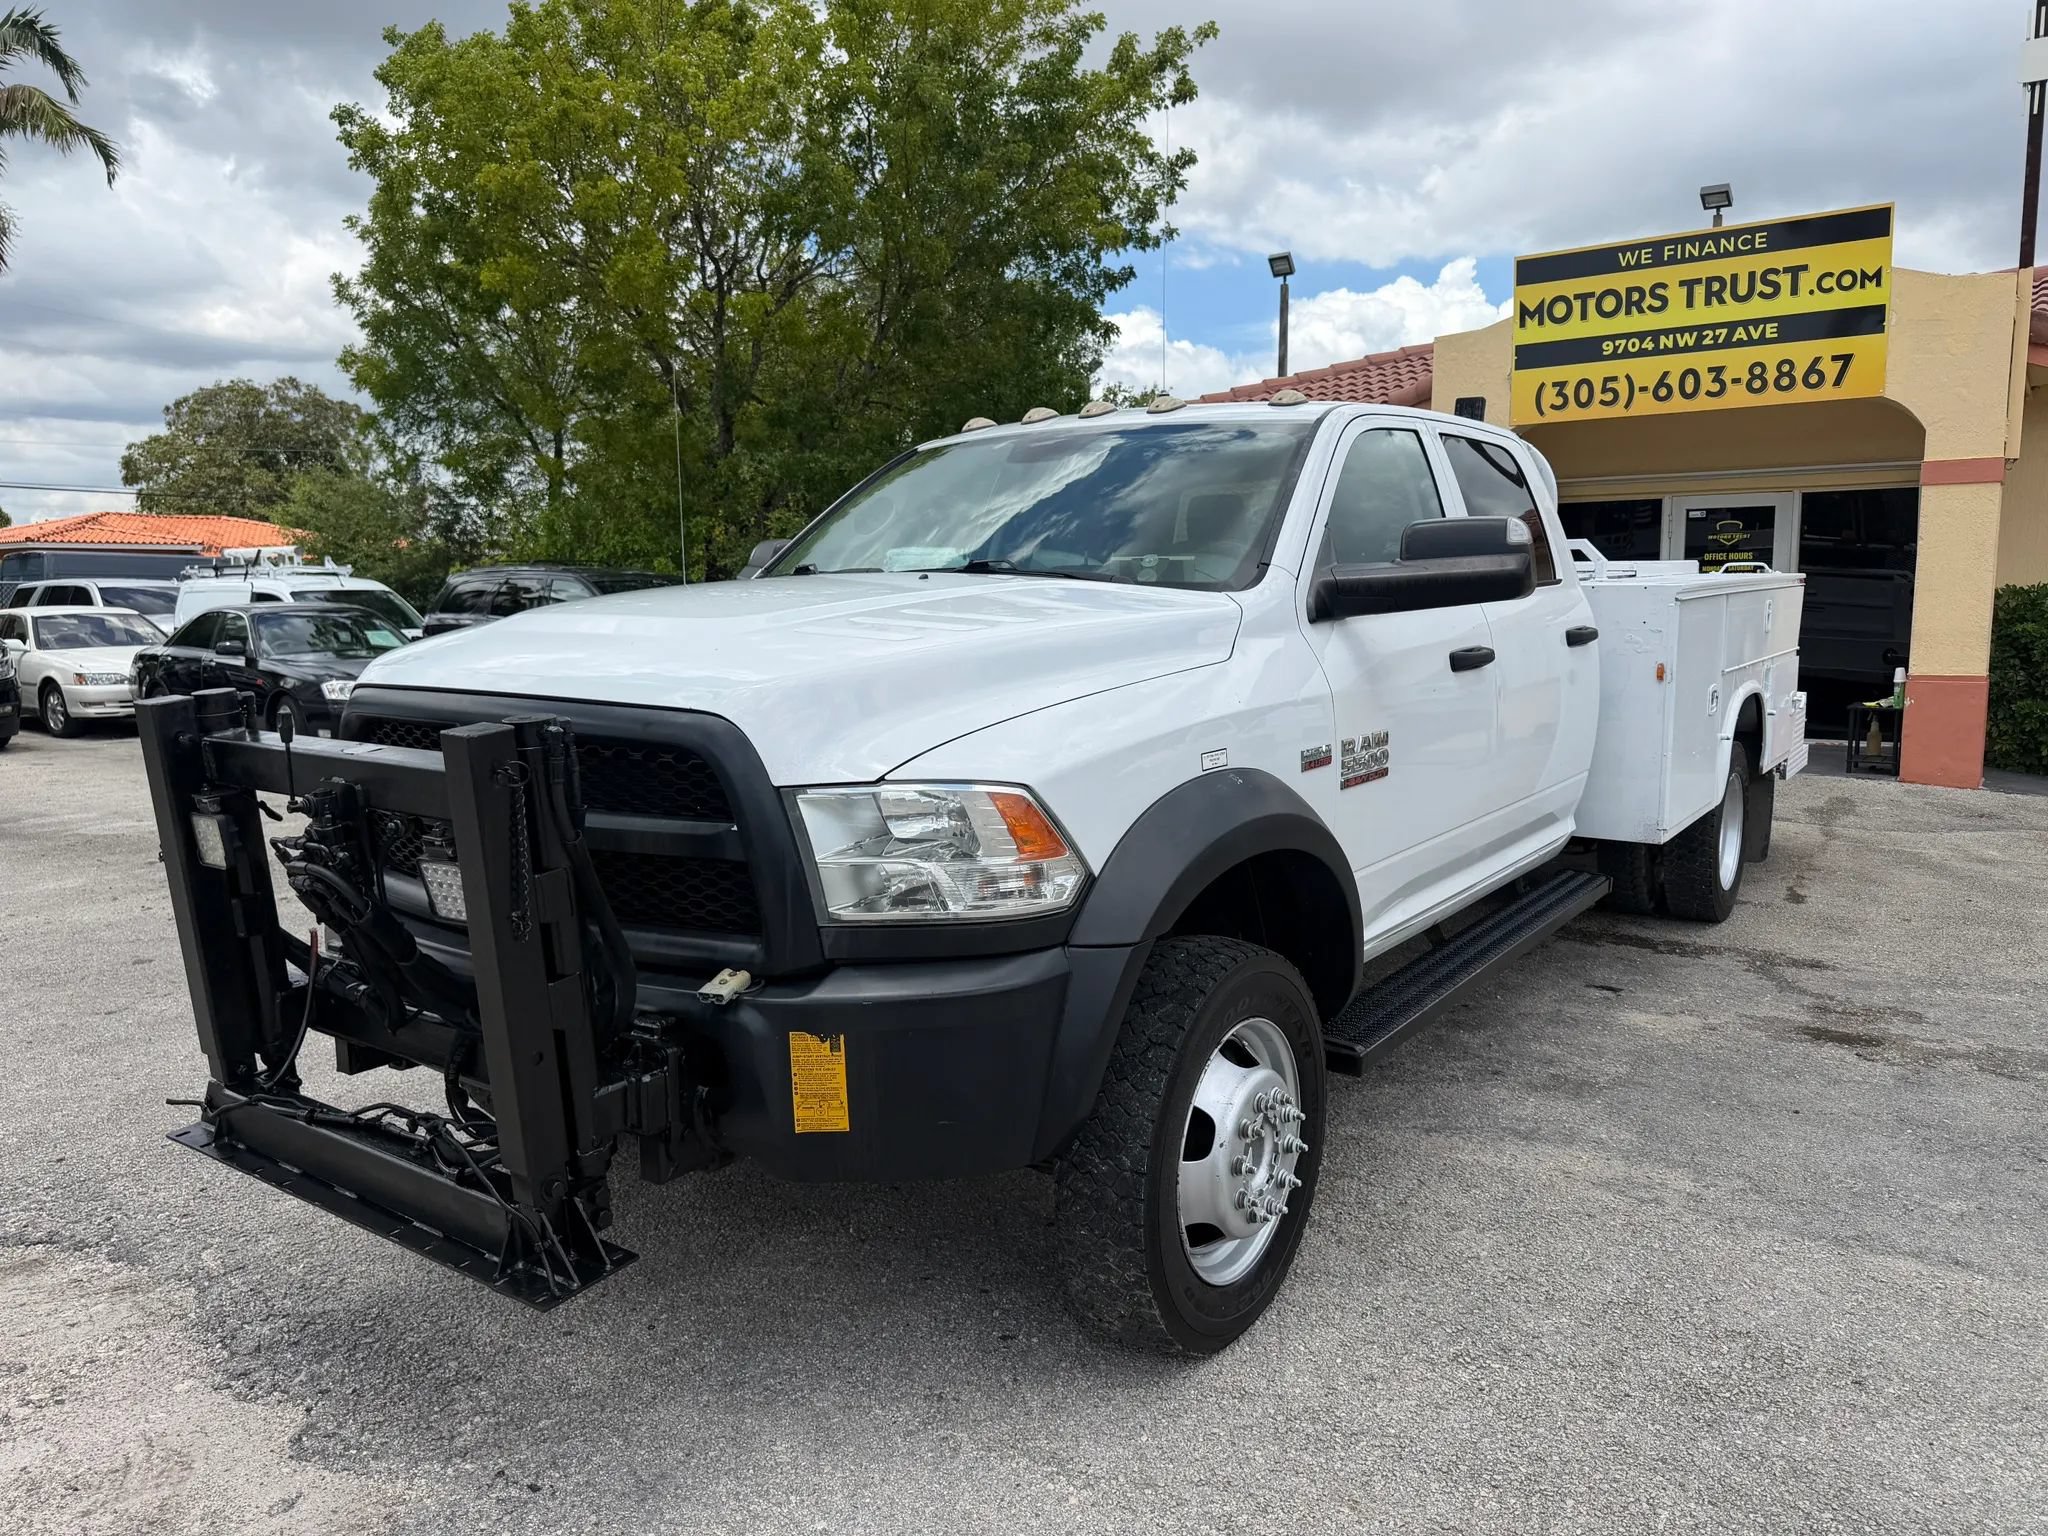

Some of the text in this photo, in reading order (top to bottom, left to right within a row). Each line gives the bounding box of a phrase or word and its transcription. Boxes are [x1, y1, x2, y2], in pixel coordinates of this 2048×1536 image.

[1618, 231, 1769, 267] WE FINANCE
[1519, 264, 1883, 329] MOTORS TRUST.COM
[1602, 322, 1779, 356] 9704 NW 27 AVE
[1534, 352, 1856, 418] (305)-603-8867
[1728, 552, 1753, 560] HOURS
[1341, 731, 1389, 757] RAM
[1344, 769, 1388, 789] HEAVY DUTY
